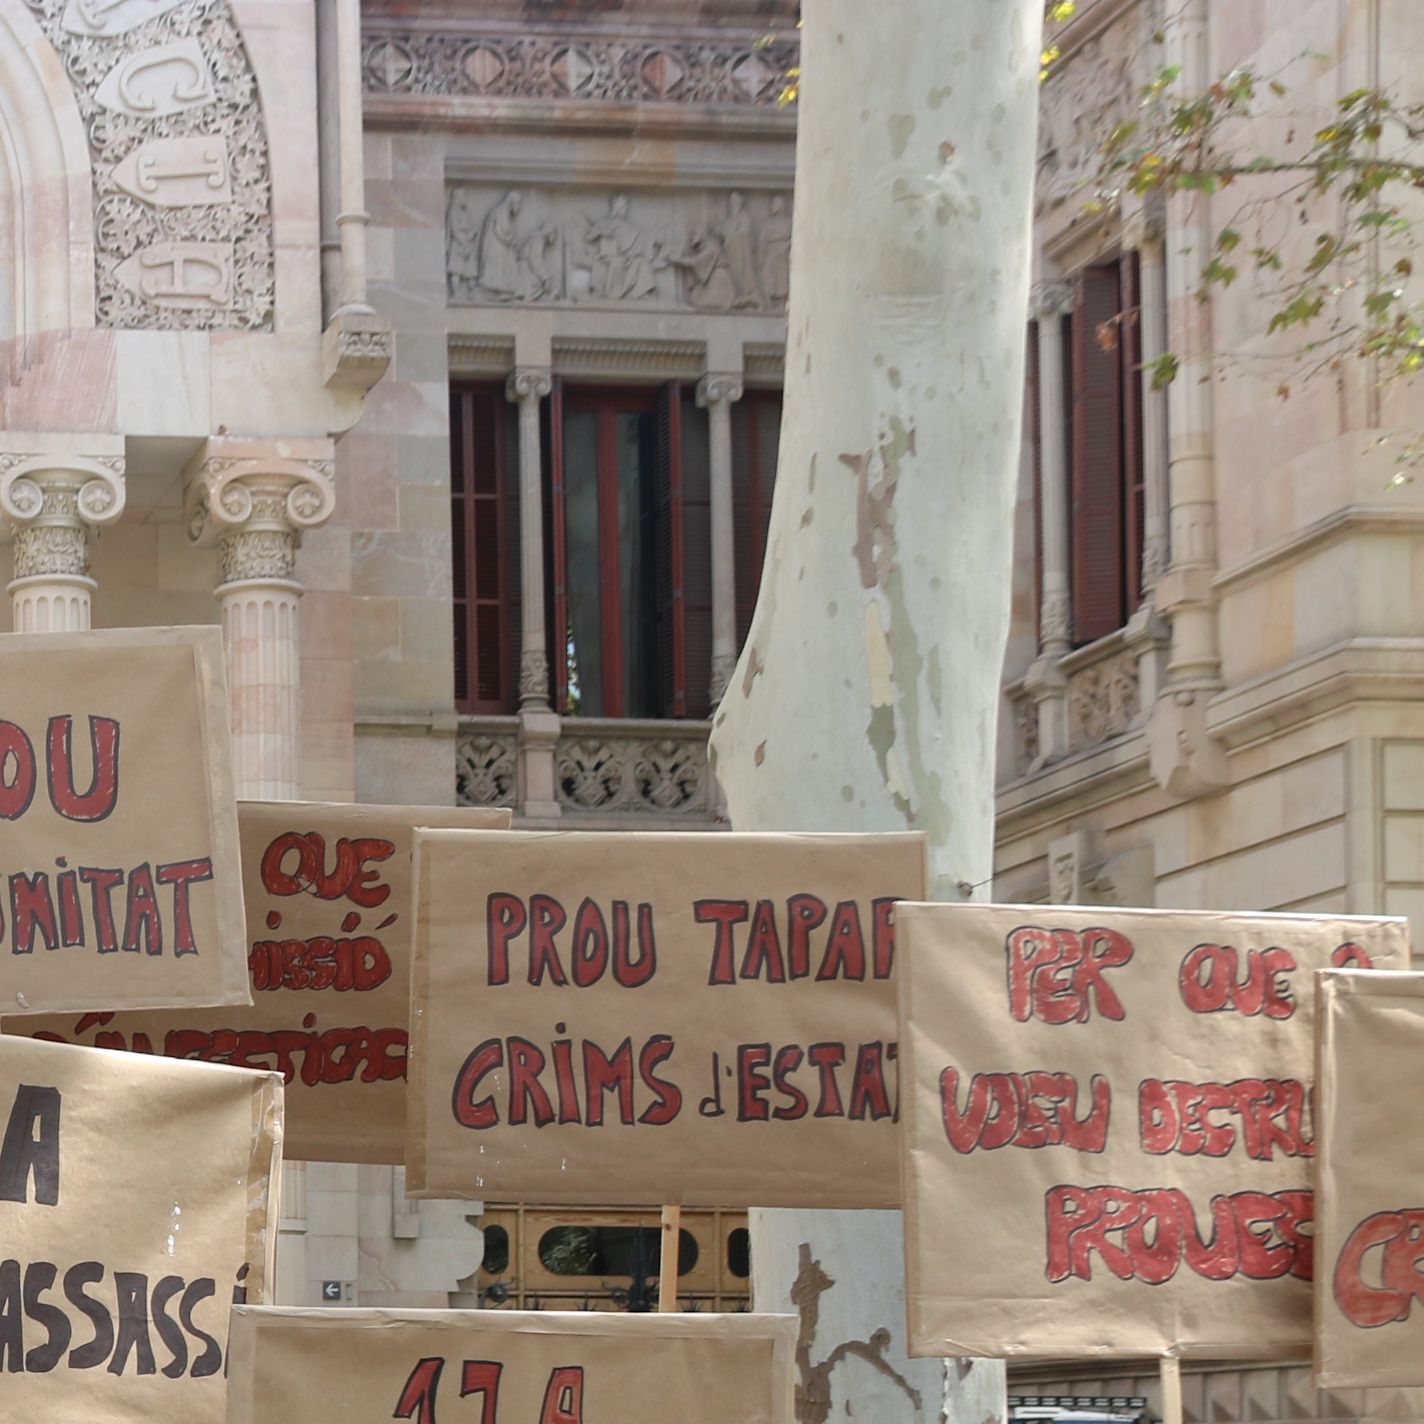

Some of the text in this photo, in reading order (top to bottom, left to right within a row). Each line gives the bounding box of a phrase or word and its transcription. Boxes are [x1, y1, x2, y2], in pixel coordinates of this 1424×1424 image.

[486, 892, 657, 988] PROU
[1005, 925, 1135, 1025] PER
[452, 1022, 898, 1130] CRIMS d'ESTA
[939, 1065, 1113, 1155] VOLEU
